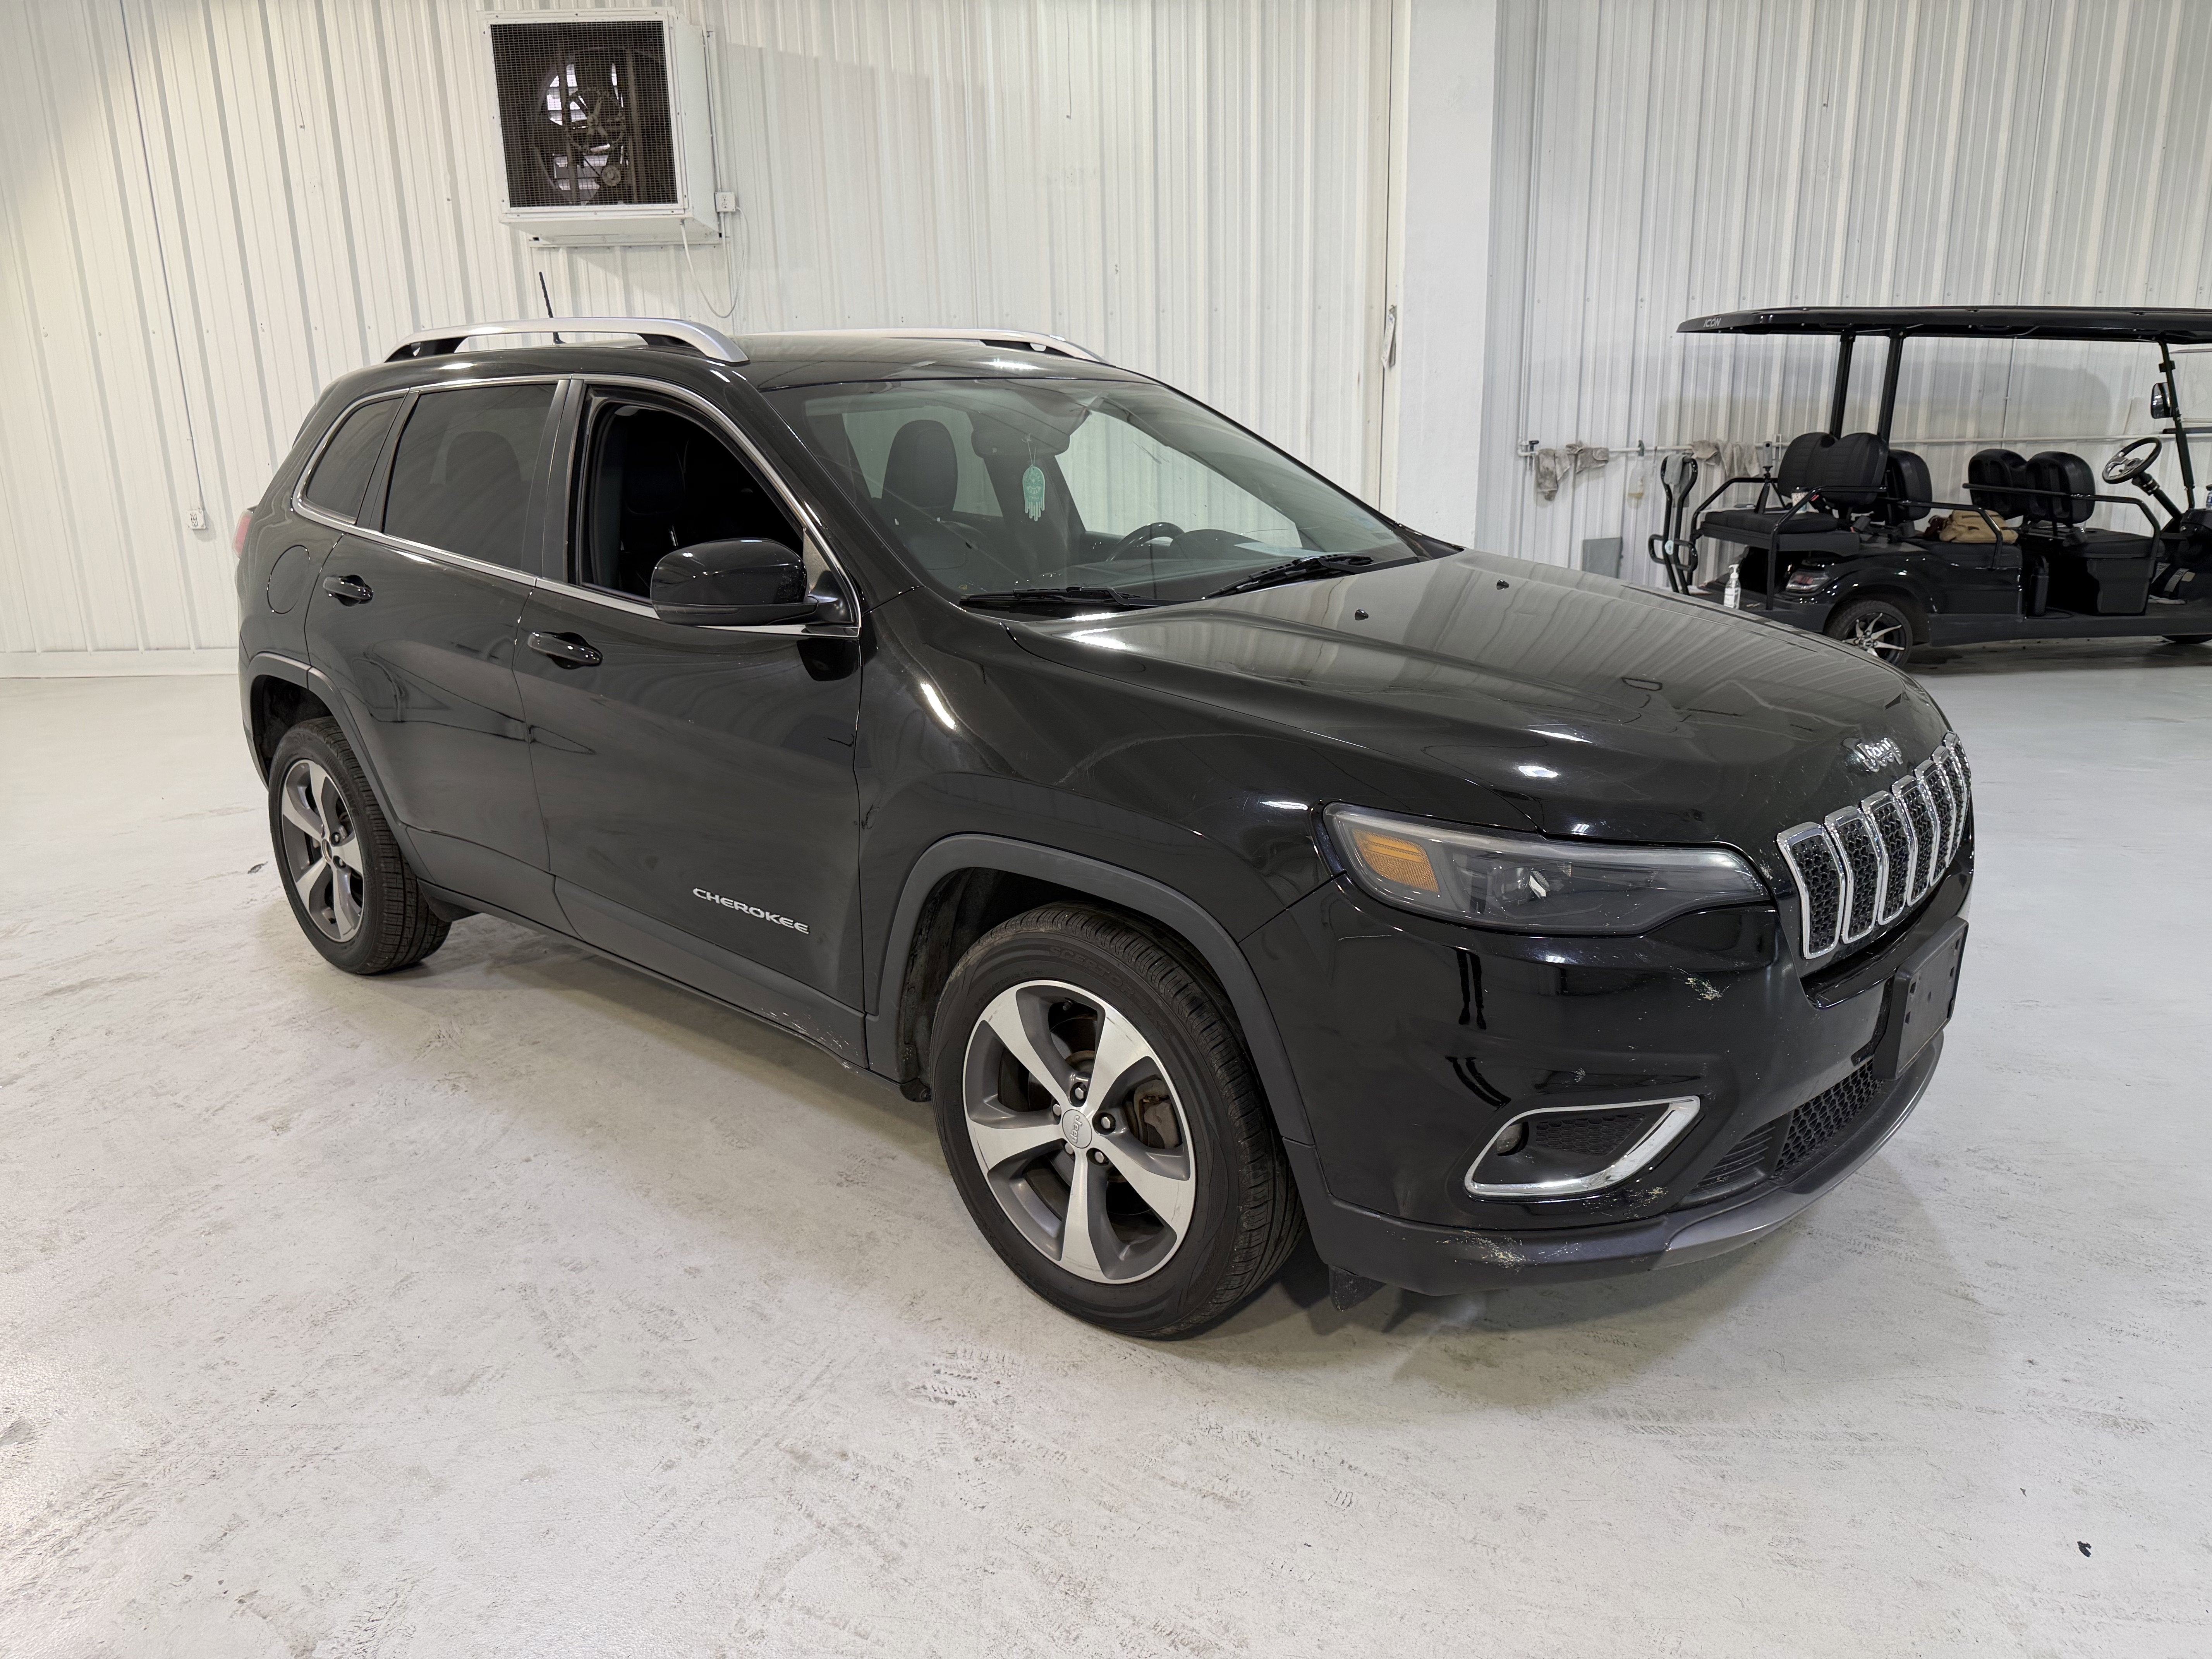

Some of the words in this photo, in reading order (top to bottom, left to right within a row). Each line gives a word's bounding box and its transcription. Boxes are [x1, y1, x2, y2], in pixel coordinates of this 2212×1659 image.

[1703, 318, 1721, 327] ICON
[693, 888, 809, 934] CHEROKEE
[1049, 946, 1135, 998] SCEPTOR
[1070, 1115, 1082, 1143] Jeep
